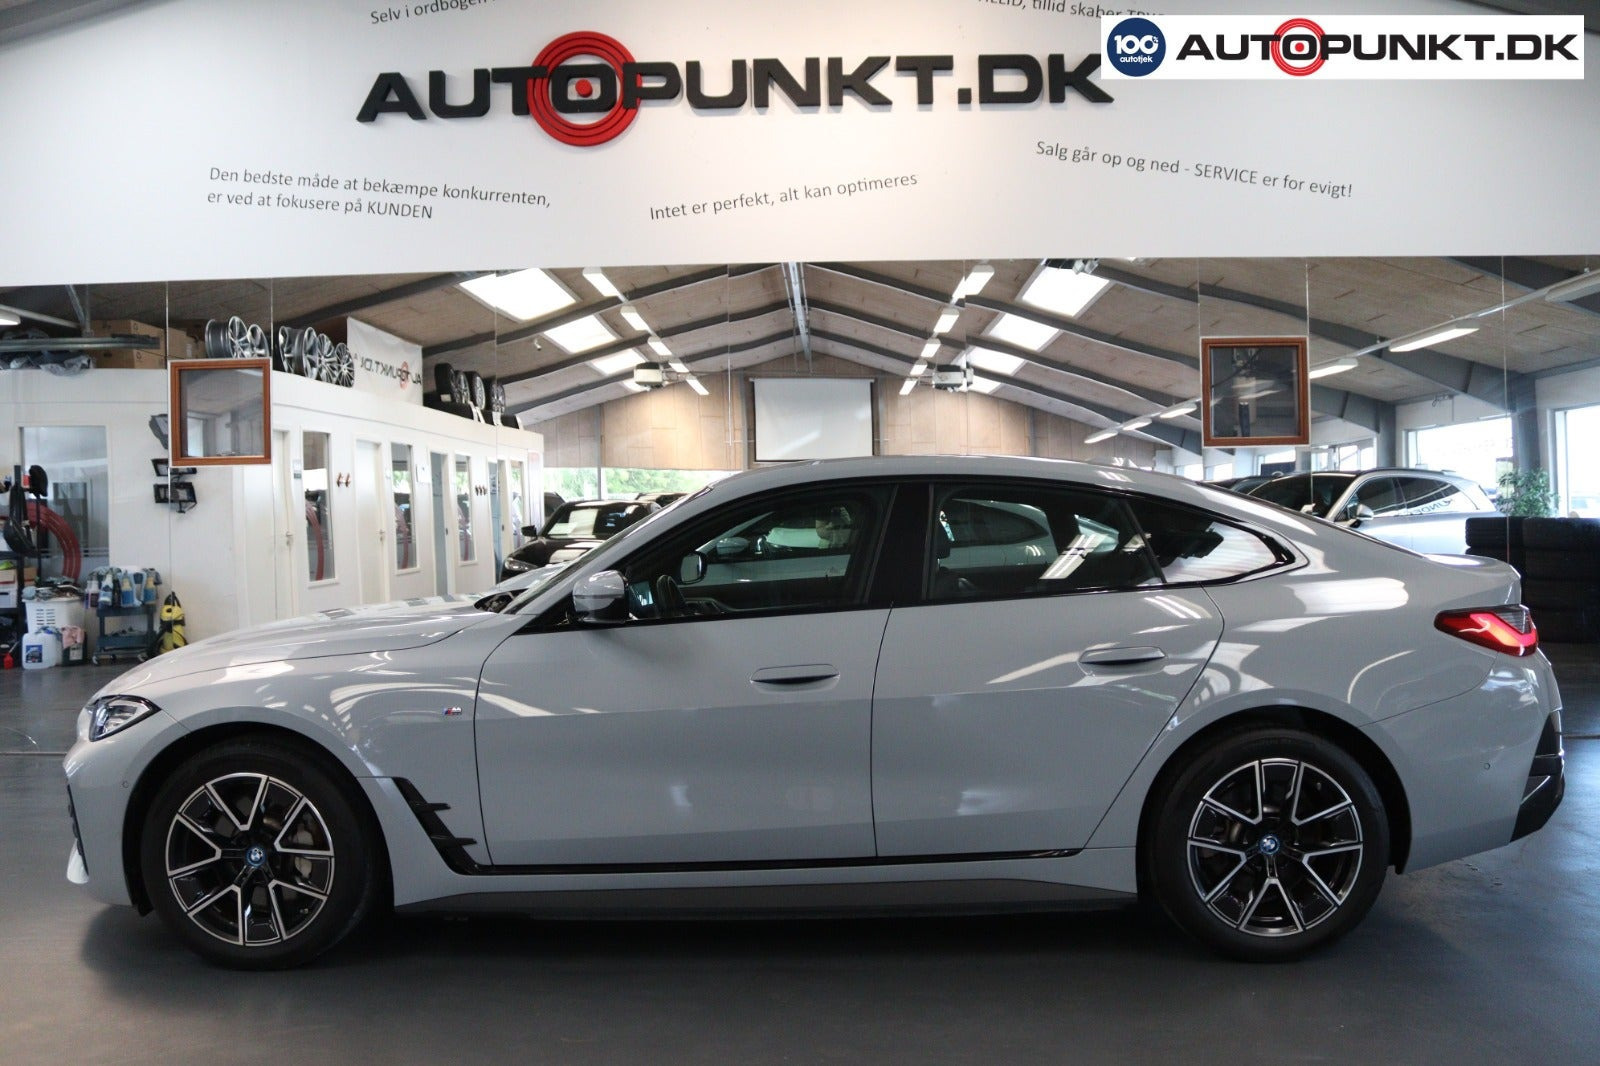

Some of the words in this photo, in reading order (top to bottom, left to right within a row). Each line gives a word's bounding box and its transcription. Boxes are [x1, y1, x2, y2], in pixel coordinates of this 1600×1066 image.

[370, 8, 401, 24] Selv
[405, 5, 410, 18] i
[356, 53, 1114, 122] AUTOPUNKT.DK
[209, 167, 238, 182] Den
[243, 169, 293, 186] bedste
[297, 173, 339, 190] måde
[343, 178, 359, 191] at
[363, 177, 438, 199] bekæmpe
[442, 184, 551, 209] konkurrenten,
[1036, 141, 1068, 161] Salg
[1072, 146, 1097, 163] går
[1102, 153, 1122, 168] op
[1126, 156, 1146, 172] og
[1150, 160, 1180, 173] ned
[1194, 163, 1259, 185] SERVICE
[1262, 175, 1279, 187] er
[1283, 174, 1305, 191] for
[1309, 181, 1353, 199] evigt!
[207, 192, 223, 203] er
[226, 191, 253, 205] ved
[257, 194, 272, 207] at
[276, 193, 340, 211] fokusere
[344, 198, 363, 214] på
[367, 201, 433, 219] KUNDEN
[649, 202, 688, 220] Intet
[691, 202, 709, 215] er
[712, 191, 775, 215] perfekt,
[779, 186, 801, 203] alt
[803, 185, 833, 199] kan
[836, 174, 918, 197] optimeres
